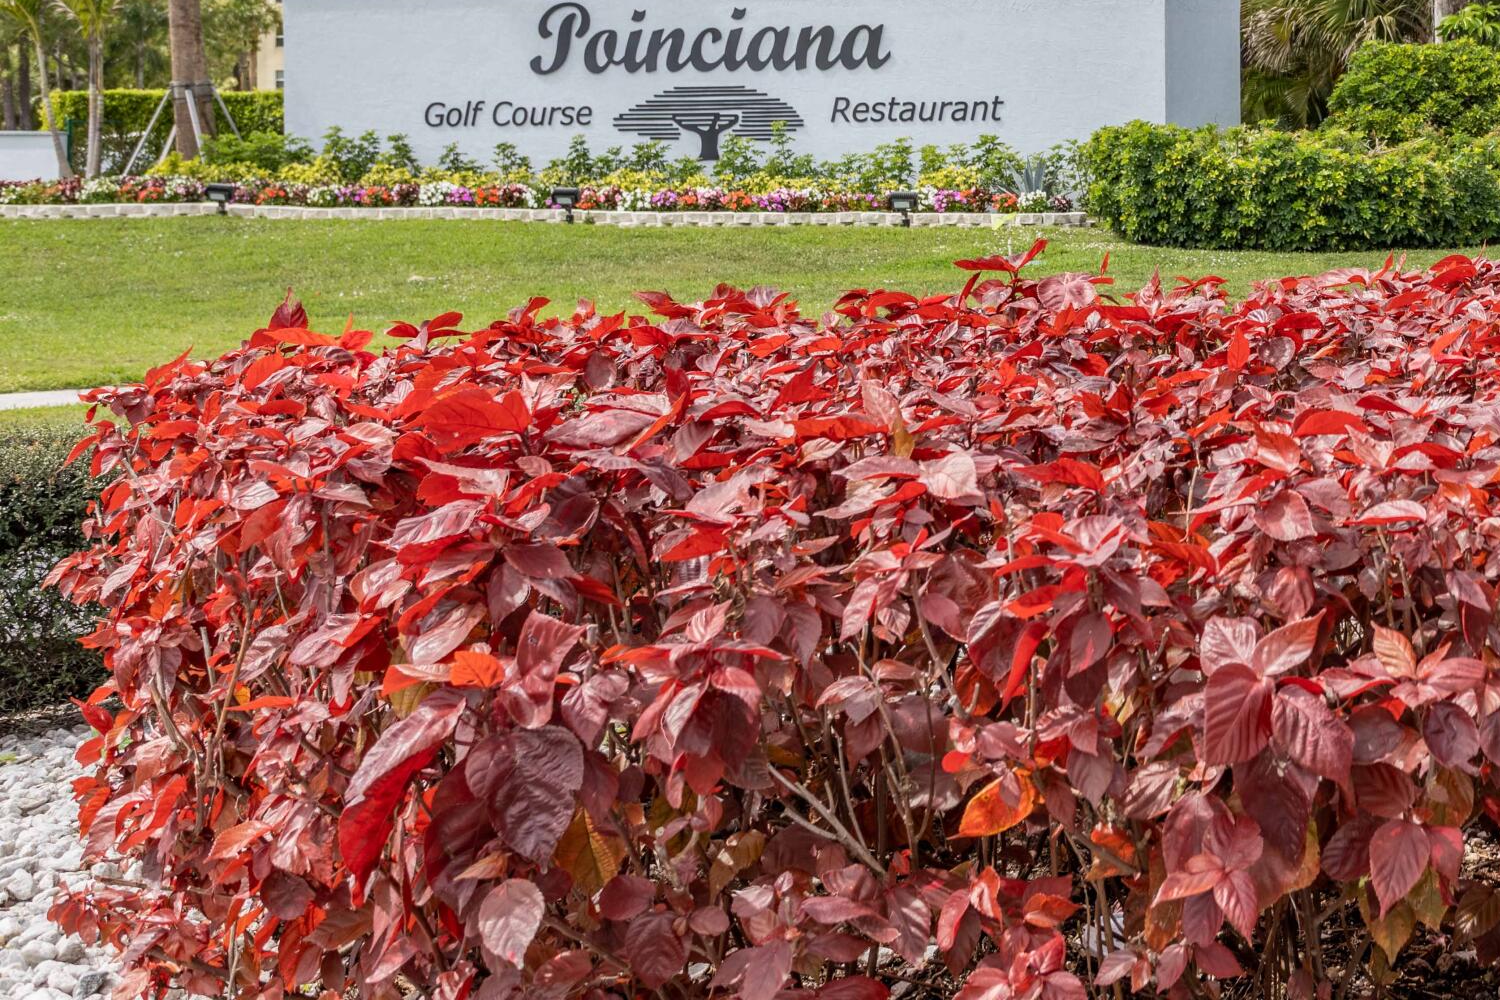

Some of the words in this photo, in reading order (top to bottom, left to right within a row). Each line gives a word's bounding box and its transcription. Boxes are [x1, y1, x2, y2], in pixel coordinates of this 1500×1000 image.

[529, 1, 892, 76] Poinciana
[424, 99, 488, 128] Golf
[491, 101, 594, 128] Course
[830, 95, 1005, 123] Restaurant
